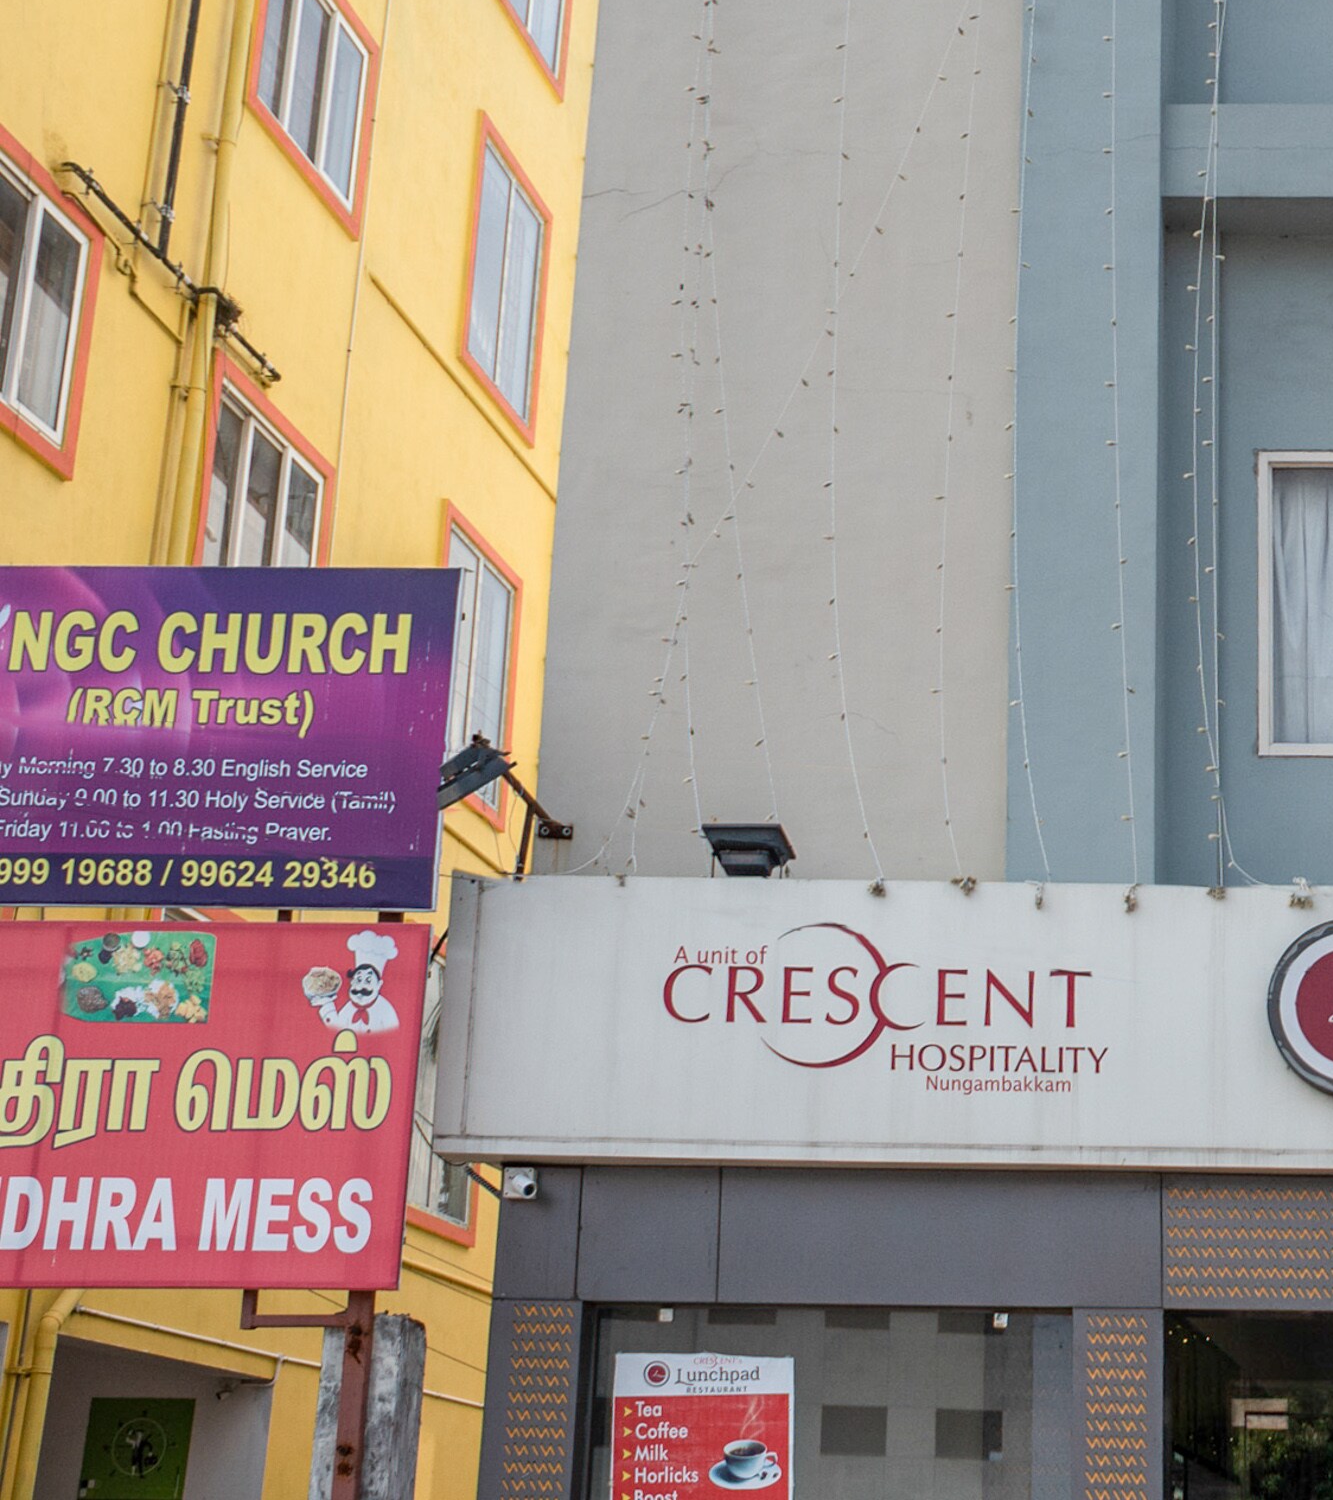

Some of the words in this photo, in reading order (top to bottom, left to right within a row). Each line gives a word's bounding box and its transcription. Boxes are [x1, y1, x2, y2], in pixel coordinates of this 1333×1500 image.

[7, 609, 139, 673] NGC
[157, 610, 413, 674] CHURCH
[66, 686, 178, 729] (RCM
[191, 688, 316, 739] Trust)
[18, 756, 96, 779] Morning
[102, 756, 145, 777] 7.30
[149, 759, 169, 777] to
[172, 757, 216, 777] 8.30
[221, 758, 291, 781] English
[296, 758, 368, 778] Service
[123, 789, 142, 808] to
[149, 789, 200, 808] 11.30
[205, 789, 248, 813] Holy
[254, 788, 325, 810] Service
[331, 790, 397, 814] (Tamil)
[61, 858, 153, 887] 19688
[160, 859, 174, 887] /
[181, 860, 274, 888] 99624
[282, 860, 377, 889] 29346
[674, 946, 690, 965] A
[697, 946, 738, 965] unit
[746, 944, 768, 965] of
[662, 962, 1093, 1030] CRESCENT
[890, 1043, 1109, 1074] HOSPITALITY
[925, 1075, 1072, 1095] Nungambakkam
[0, 1175, 177, 1251] DHRA
[198, 1177, 374, 1254] MESS
[674, 1365, 760, 1386] Lunchpad
[686, 1385, 748, 1394] RESTAURANT
[635, 1400, 663, 1418] Tea
[635, 1421, 689, 1440] Coffee
[634, 1443, 669, 1462] Milk
[634, 1465, 699, 1484] Horlicks
